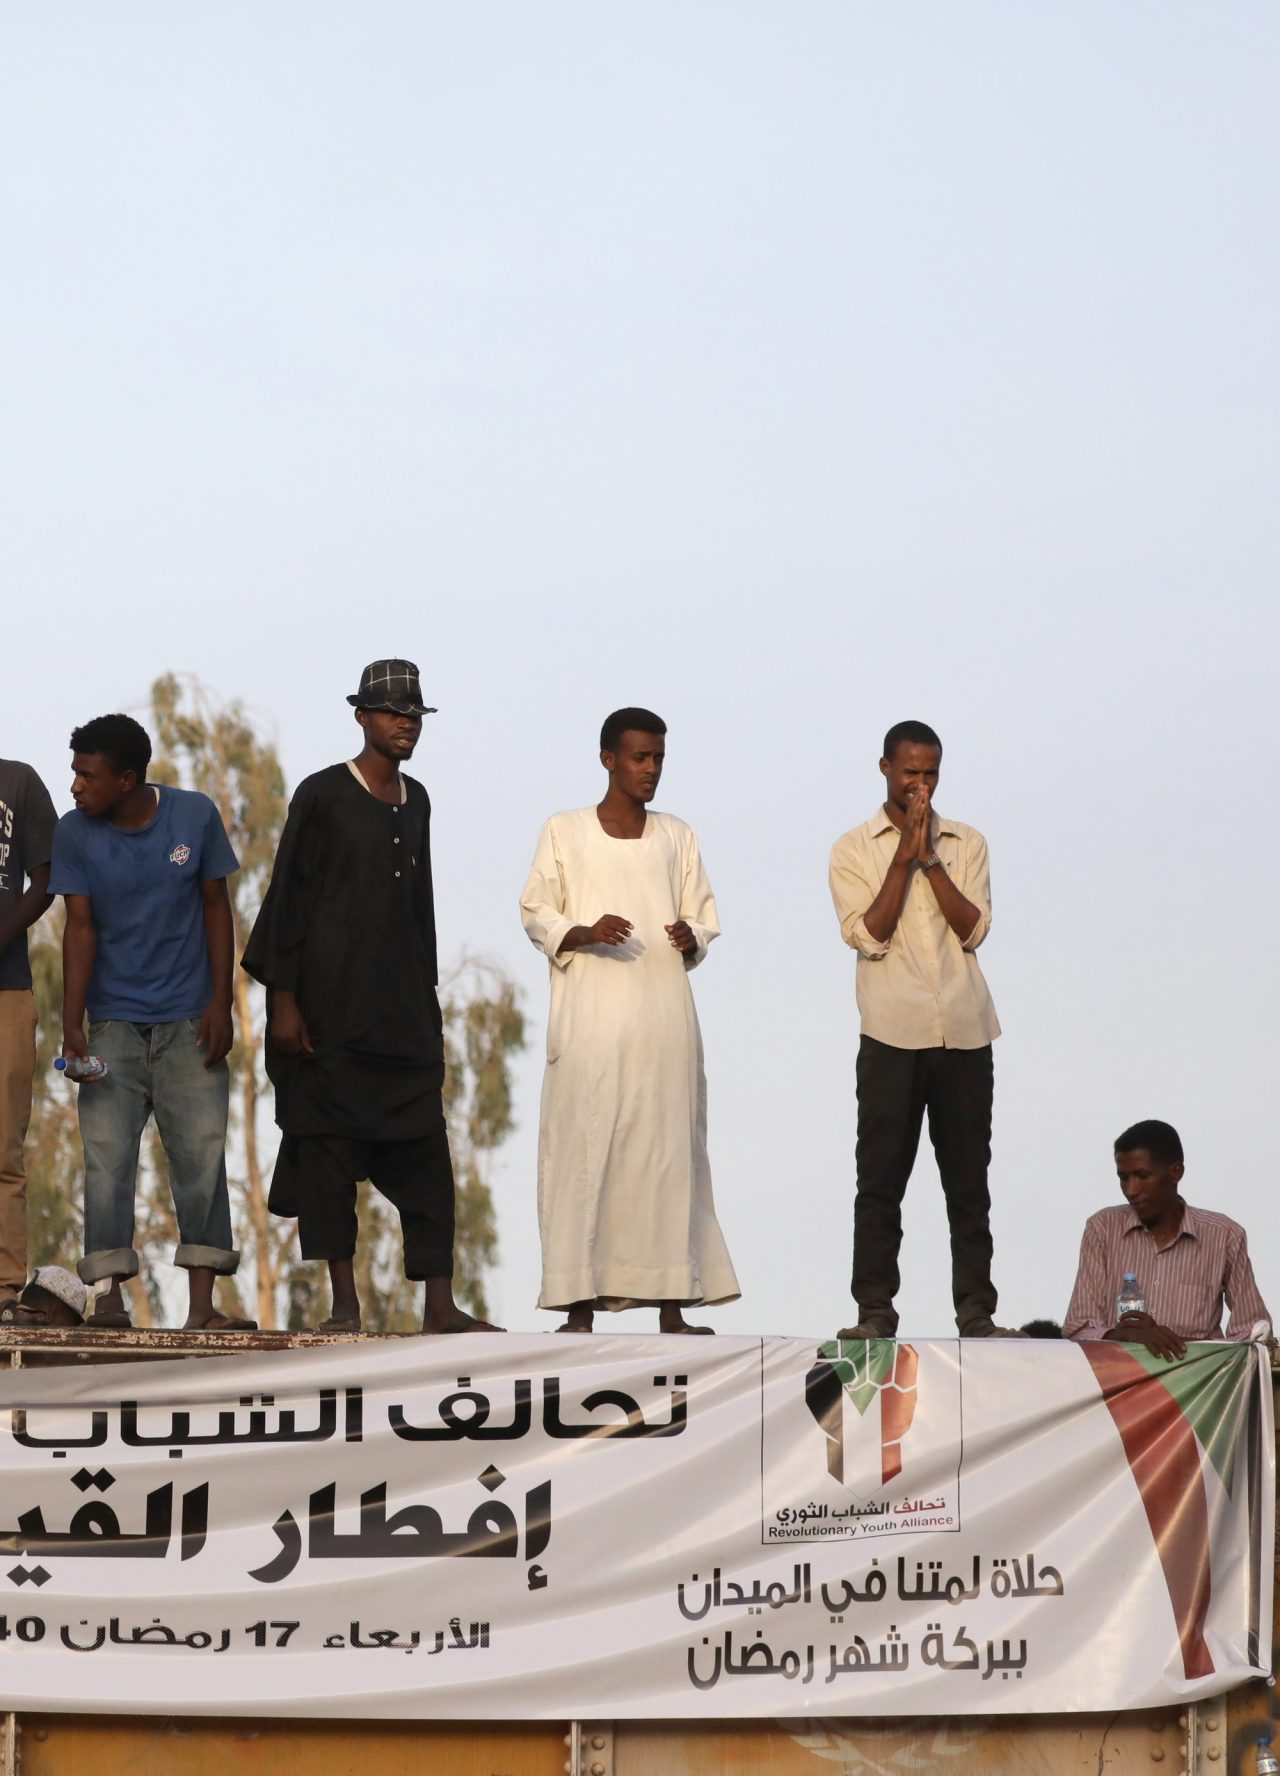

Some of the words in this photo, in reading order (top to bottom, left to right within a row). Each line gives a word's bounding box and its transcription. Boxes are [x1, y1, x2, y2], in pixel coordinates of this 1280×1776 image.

[388, 1375, 688, 1441] تحالف
[248, 1464, 552, 1591] إفطار
[769, 1524, 857, 1538] Revolutionary
[861, 1521, 896, 1533] Youth
[900, 1516, 953, 1528] Alliance
[776, 1503, 827, 1525] الثوري
[832, 1501, 889, 1521] الشباب
[893, 1498, 946, 1514] تحالف
[677, 1563, 811, 1621] الميدان
[822, 1558, 887, 1623] في
[898, 1555, 980, 1605] لمتنا
[991, 1553, 1064, 1598] حلاة
[61, 1617, 229, 1652] رمضان
[244, 1621, 300, 1648] 17
[323, 1617, 490, 1654] الأربعاء
[825, 1625, 909, 1683] شهر
[920, 1623, 1027, 1680] ببركة
[688, 1630, 814, 1690] رمضان
